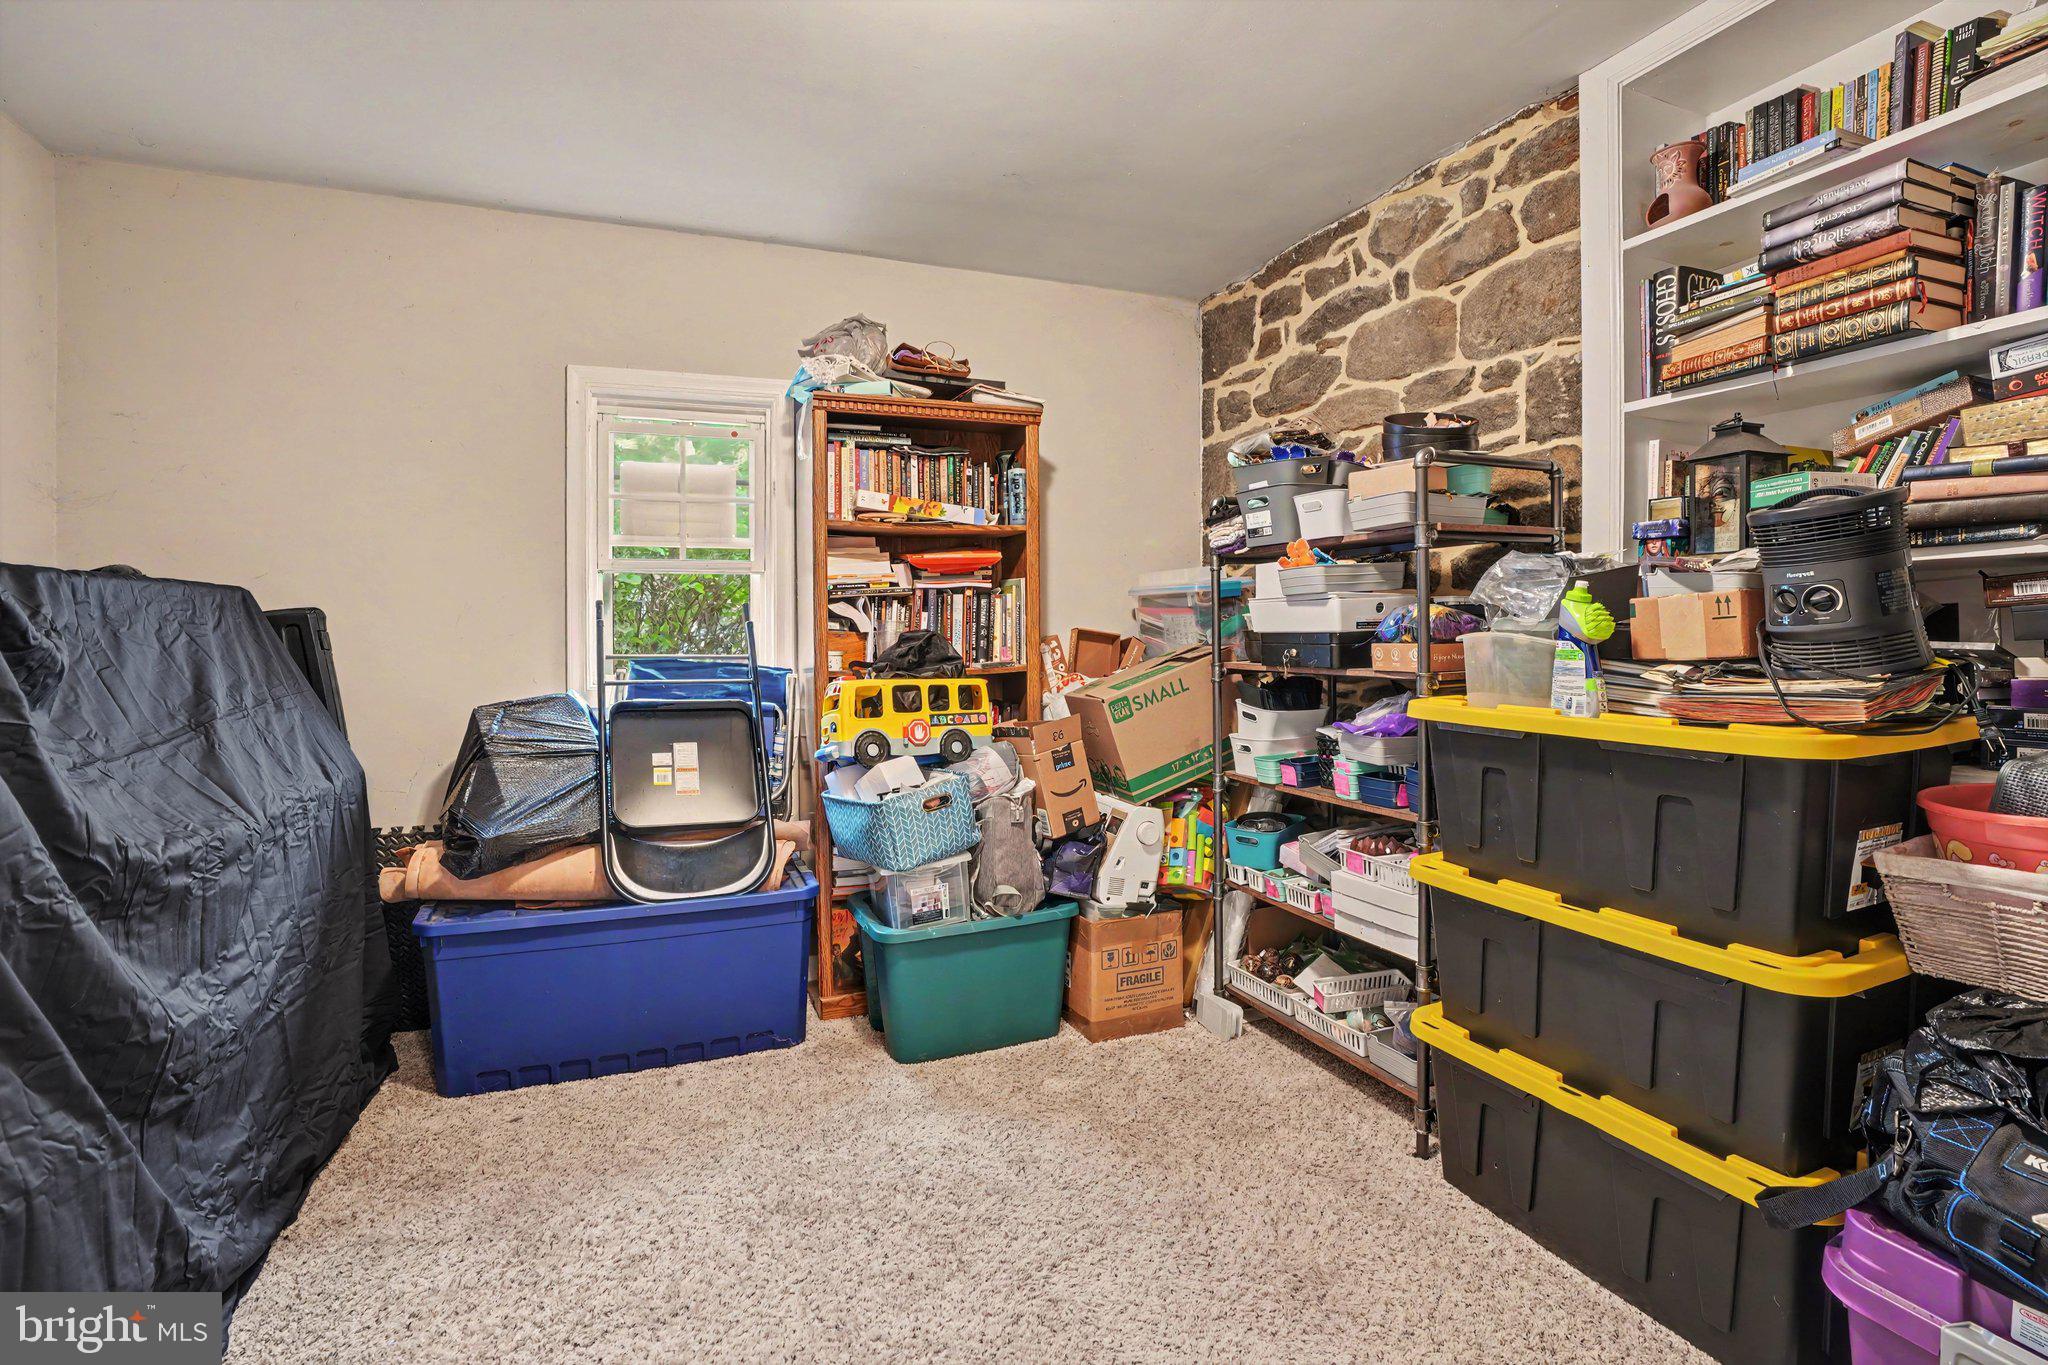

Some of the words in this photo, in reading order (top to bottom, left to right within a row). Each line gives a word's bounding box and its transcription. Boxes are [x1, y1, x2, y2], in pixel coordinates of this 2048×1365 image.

[1956, 54, 1970, 73] THE
[2029, 191, 2047, 251] WITCH
[1802, 223, 1853, 251] silence
[1913, 441, 1928, 465] CRAFT
[1786, 570, 1815, 579] Honeywell
[1132, 678, 1190, 711] SMALL
[1120, 971, 1161, 987] FRAGILE
